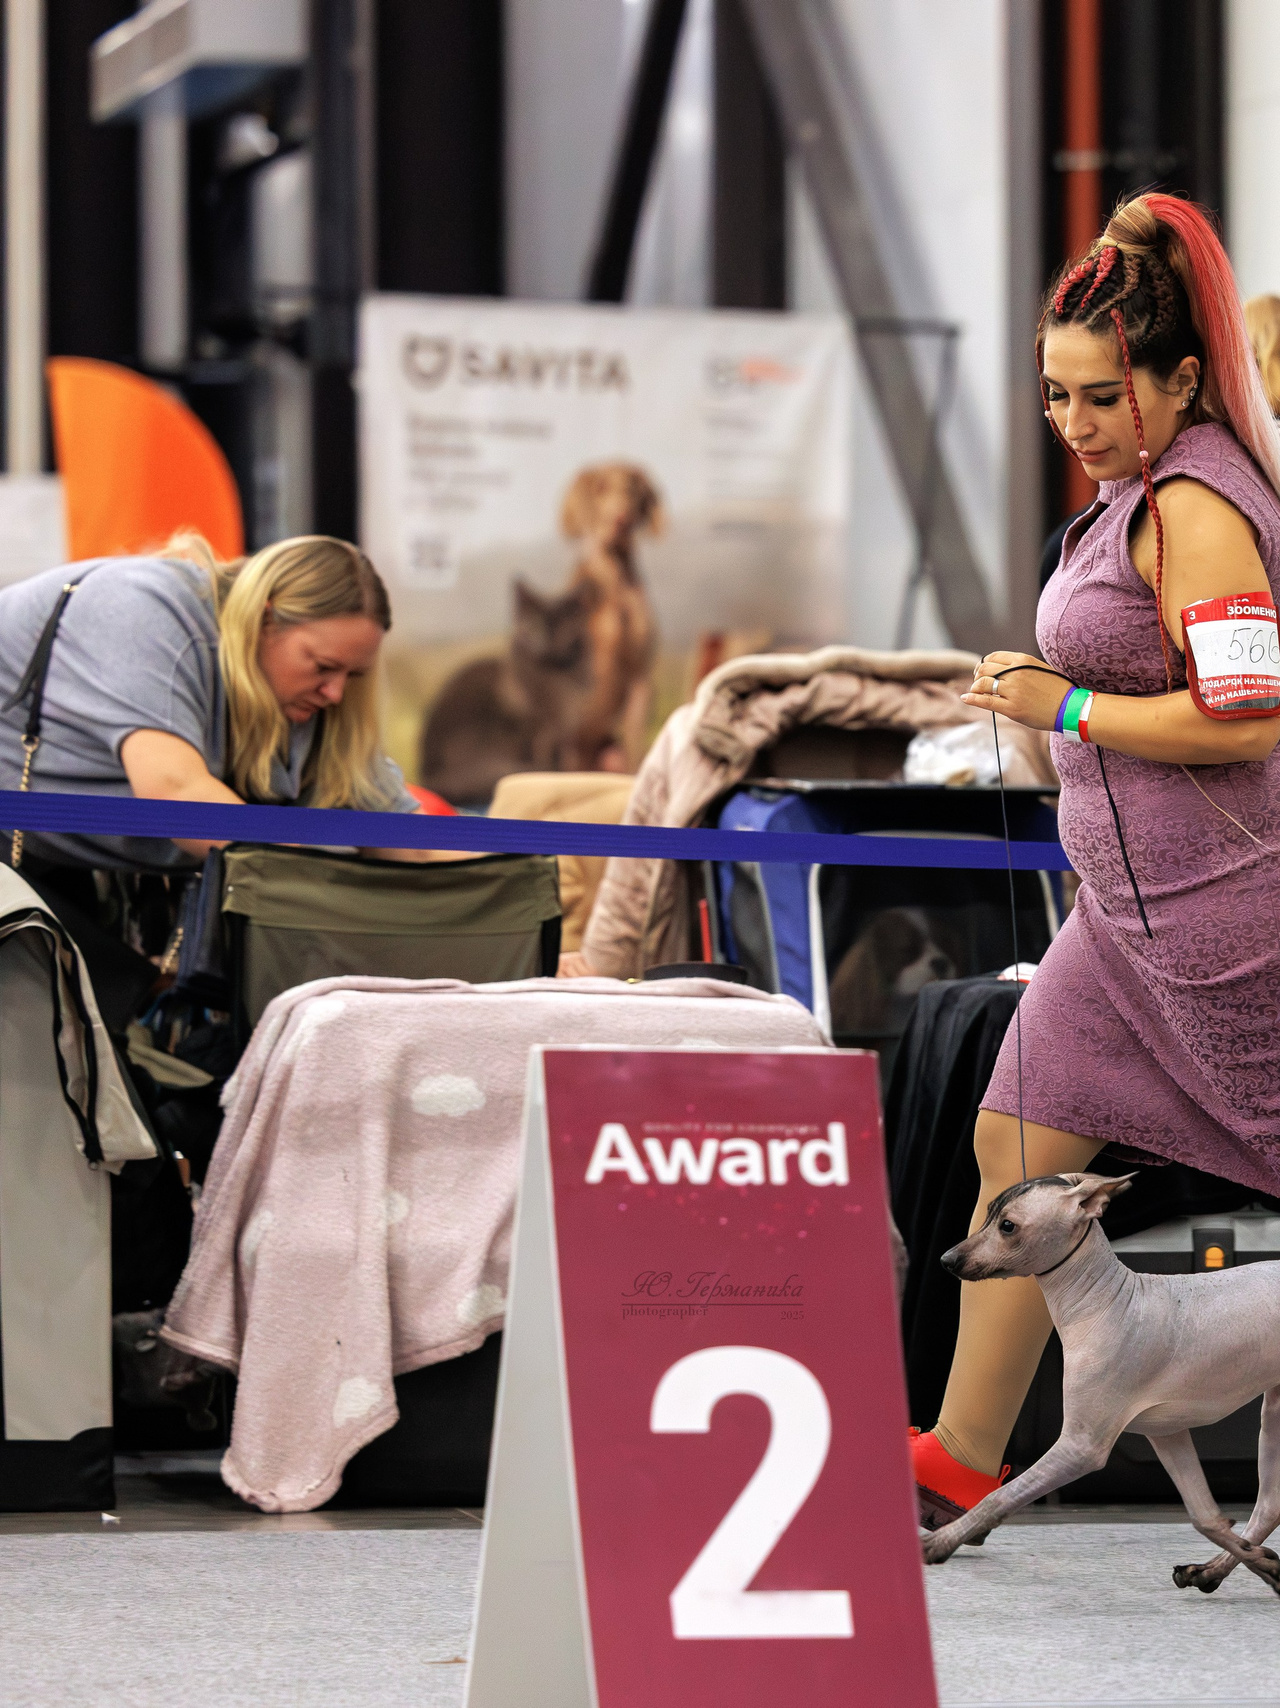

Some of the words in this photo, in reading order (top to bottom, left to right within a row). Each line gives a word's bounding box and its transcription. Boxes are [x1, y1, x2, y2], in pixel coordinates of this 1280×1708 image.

[460, 341, 630, 392] SAVITA
[1226, 605, 1278, 619] ЗООМЕНЮ
[1202, 677, 1243, 689] ПОДАРОК
[1244, 677, 1256, 685] НА
[585, 1121, 850, 1186] Award
[650, 1345, 855, 1639] 2
